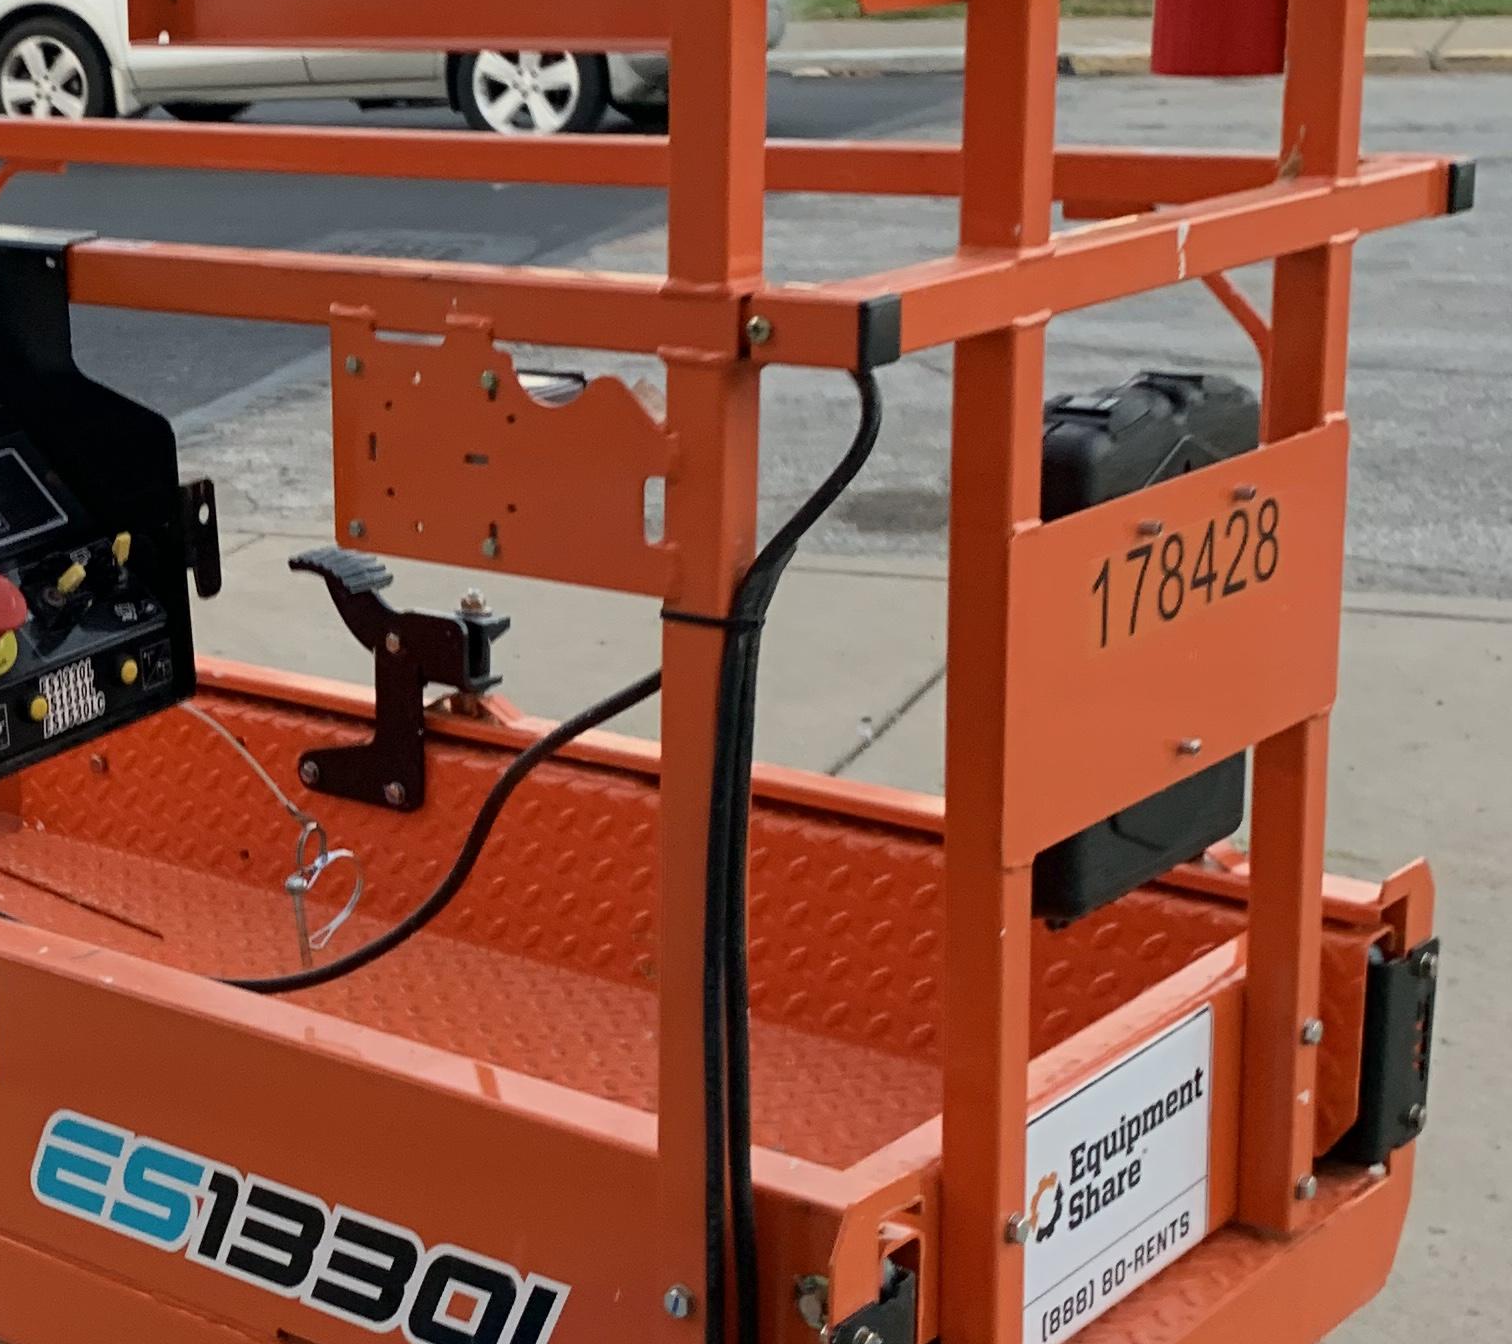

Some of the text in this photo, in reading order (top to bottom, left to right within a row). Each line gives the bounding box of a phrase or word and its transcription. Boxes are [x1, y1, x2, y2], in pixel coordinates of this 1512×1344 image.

[1092, 497, 1279, 648] 178428
[1069, 1066, 1204, 1187] Equipment
[1067, 1158, 1143, 1232] Share
[1041, 1210, 1192, 1343] (888) 80-RENTS
